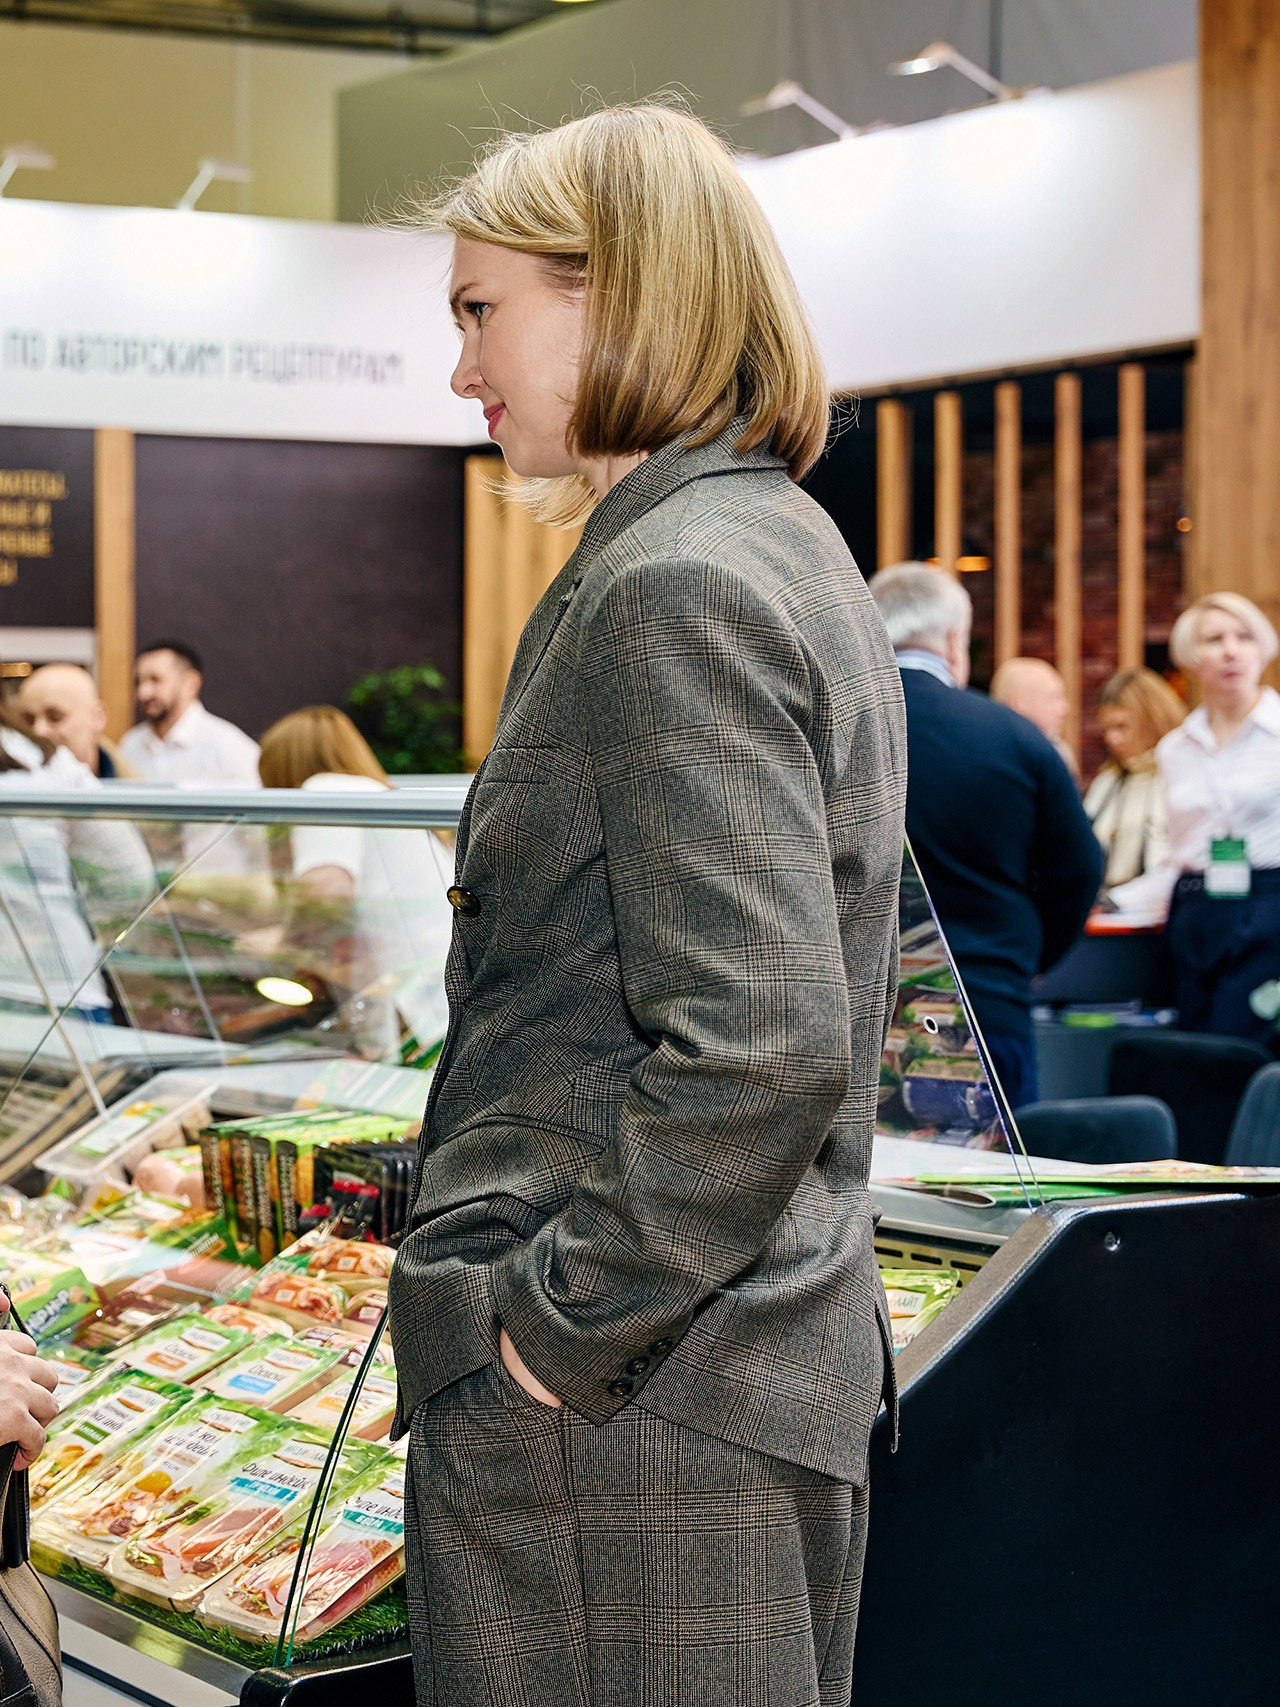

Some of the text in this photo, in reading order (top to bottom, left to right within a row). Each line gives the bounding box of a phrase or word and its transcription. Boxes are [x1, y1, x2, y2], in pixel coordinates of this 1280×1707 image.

[3, 328, 405, 386] ПО АВТОРСКИМ РЕЦЕПТУРАМ
[241, 1462, 269, 1478] Филе
